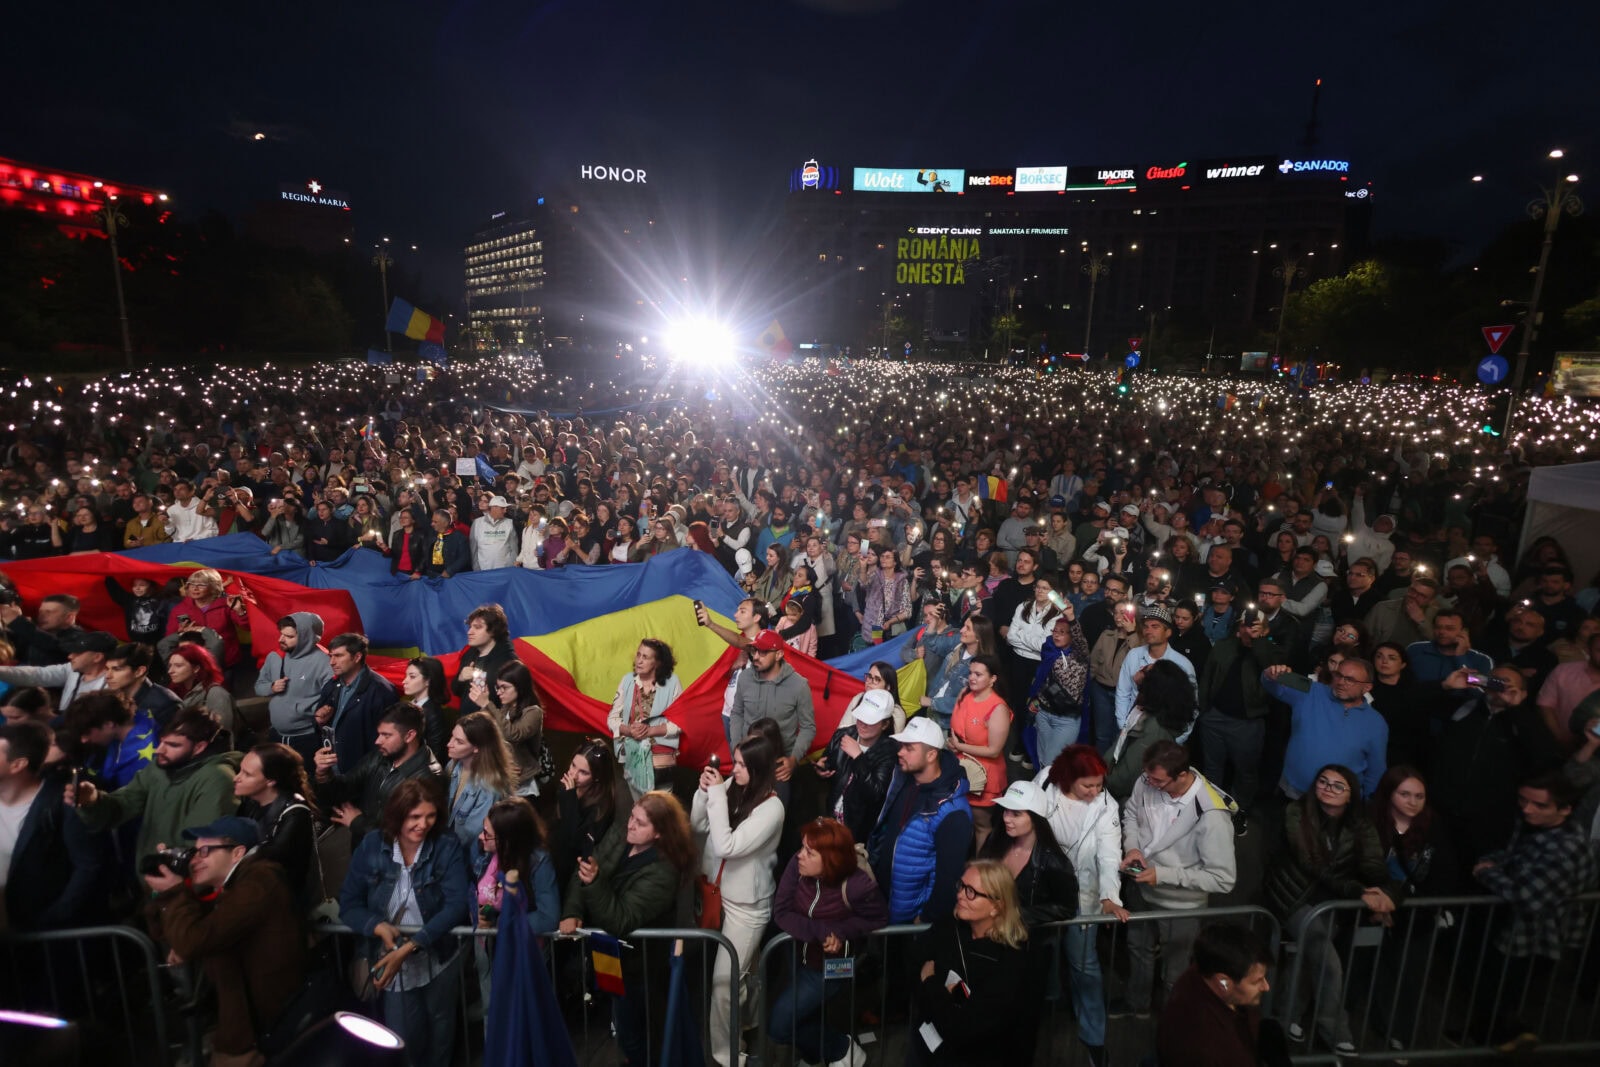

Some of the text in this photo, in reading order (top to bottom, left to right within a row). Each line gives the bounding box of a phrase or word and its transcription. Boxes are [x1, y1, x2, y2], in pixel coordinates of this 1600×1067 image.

[1146, 166, 1186, 180] Giusto
[1206, 163, 1265, 179] winner
[1293, 160, 1349, 172] SANADOR
[581, 165, 647, 184] HONOR
[864, 172, 905, 189] Wolt
[968, 175, 1013, 186] NetBet
[1020, 173, 1063, 185] BORSEC
[281, 191, 348, 207] REGINA MARIA
[952, 227, 982, 235] CLINIC
[897, 234, 981, 260] ROMÂNIA
